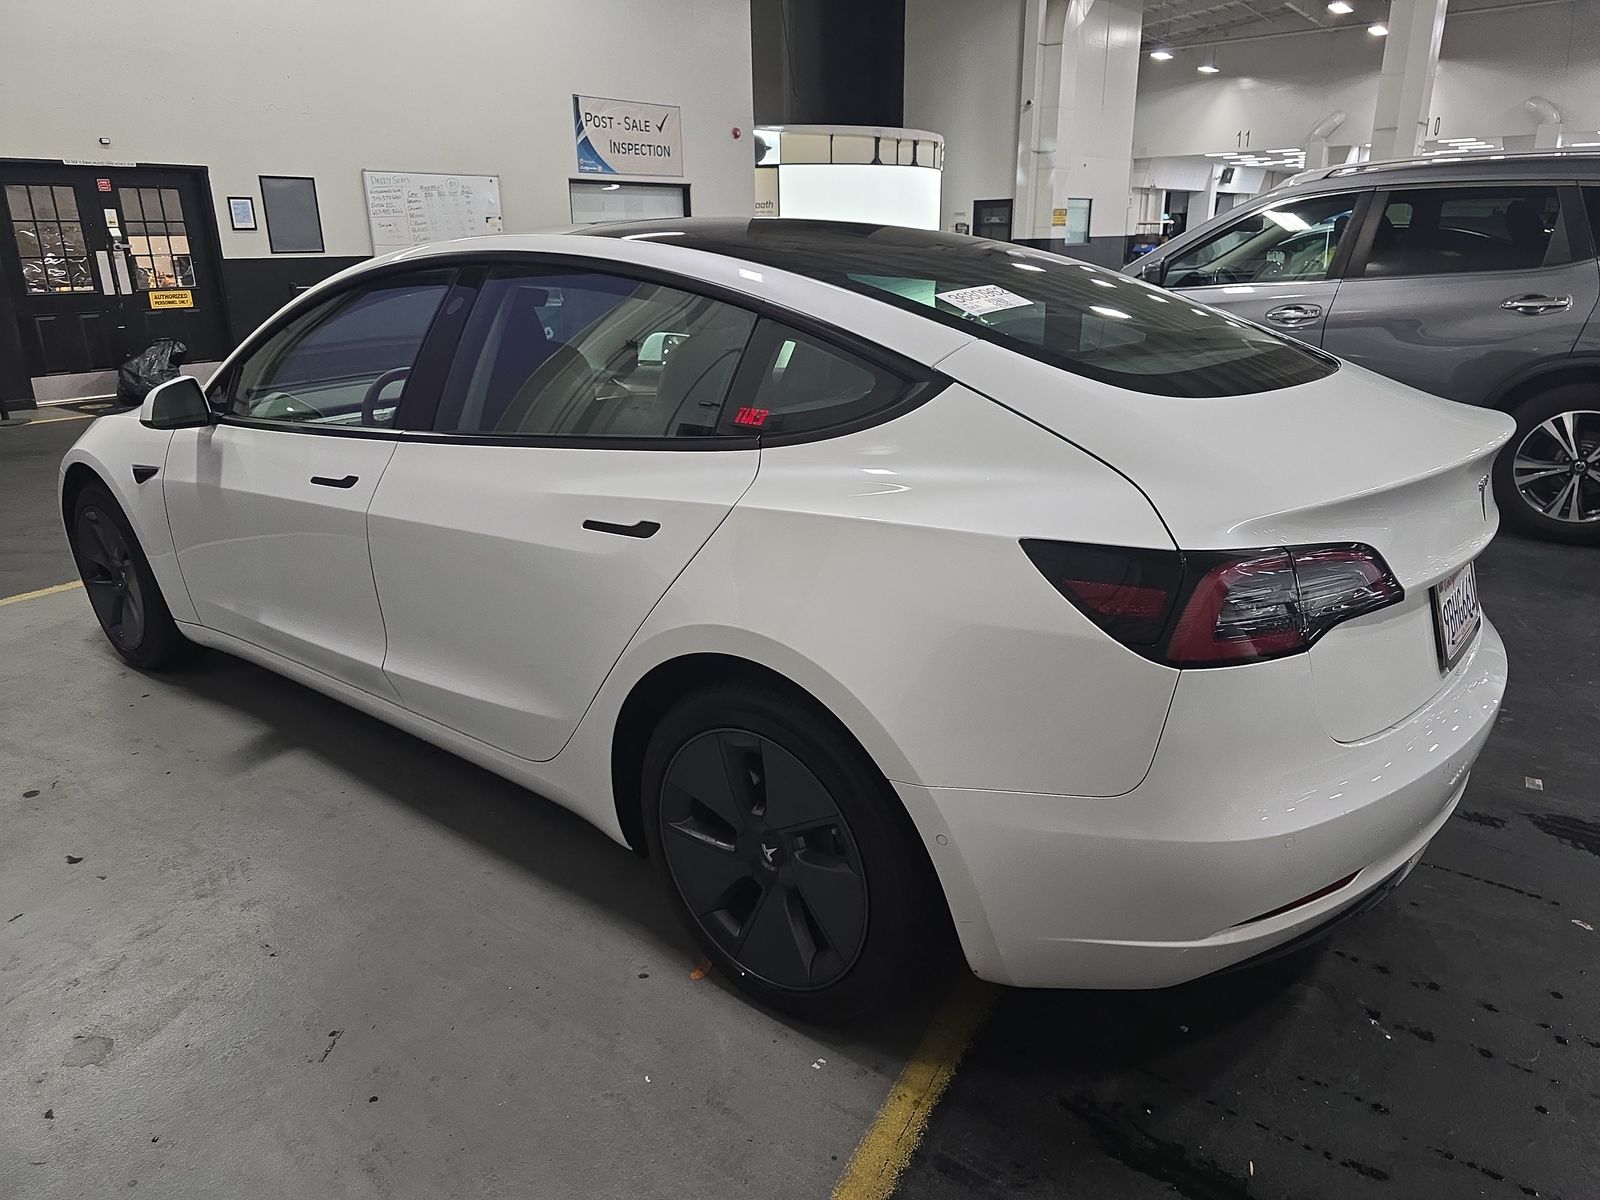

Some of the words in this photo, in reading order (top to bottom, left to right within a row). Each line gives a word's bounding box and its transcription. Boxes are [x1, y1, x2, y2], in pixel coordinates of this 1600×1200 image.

[584, 112, 614, 129] POST
[624, 116, 651, 132] SALE
[609, 139, 671, 157] INSPECTION
[1236, 129, 1250, 148] 11
[1442, 573, 1476, 646] 9BHG661
